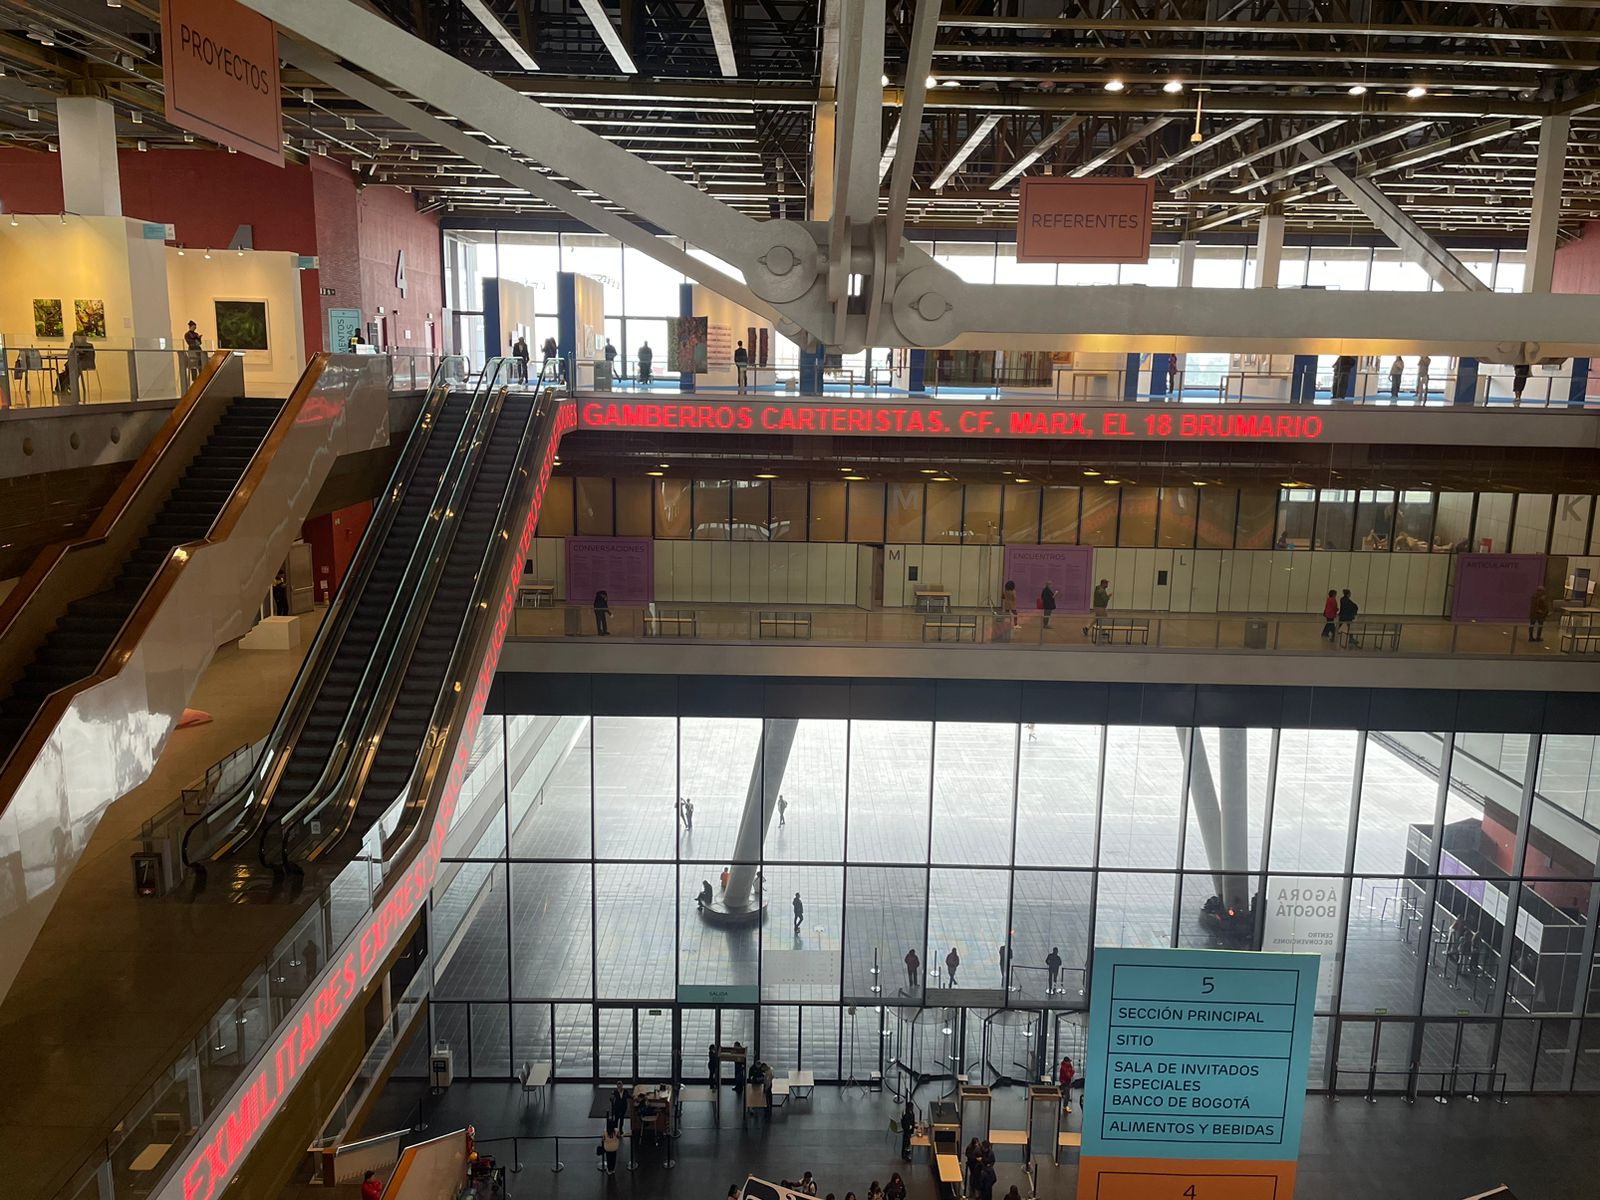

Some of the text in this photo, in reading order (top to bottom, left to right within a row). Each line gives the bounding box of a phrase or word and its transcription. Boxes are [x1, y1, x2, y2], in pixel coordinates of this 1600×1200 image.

[180, 24, 269, 95] PROYECTOS
[1031, 213, 1139, 229] REFERENTES
[395, 249, 408, 300] 4
[583, 403, 1322, 438] GAMBERROS CARTERISTAS. CF. MARX, EL 18 BRUMARIO
[1561, 495, 1585, 522] K
[573, 543, 645, 553] CONVERSACIONES
[888, 549, 901, 561] M
[1013, 551, 1066, 561] ENCUENTROS
[1201, 976, 1215, 994] 5
[1118, 1006, 1264, 1023] SECCIÓN PRINCIPAL
[1116, 1034, 1154, 1046] SITIO
[181, 952, 356, 1200] EXMILITARES
[1114, 1061, 1260, 1077] SALA DE INVITADOS
[1113, 1078, 1201, 1092] ESPECIALES
[1112, 1095, 1250, 1110] BANCO DE BOGOTÁ
[1109, 1120, 1275, 1136] ALIMENTOS Y BEBIDAS
[1183, 1184, 1197, 1200] 4
